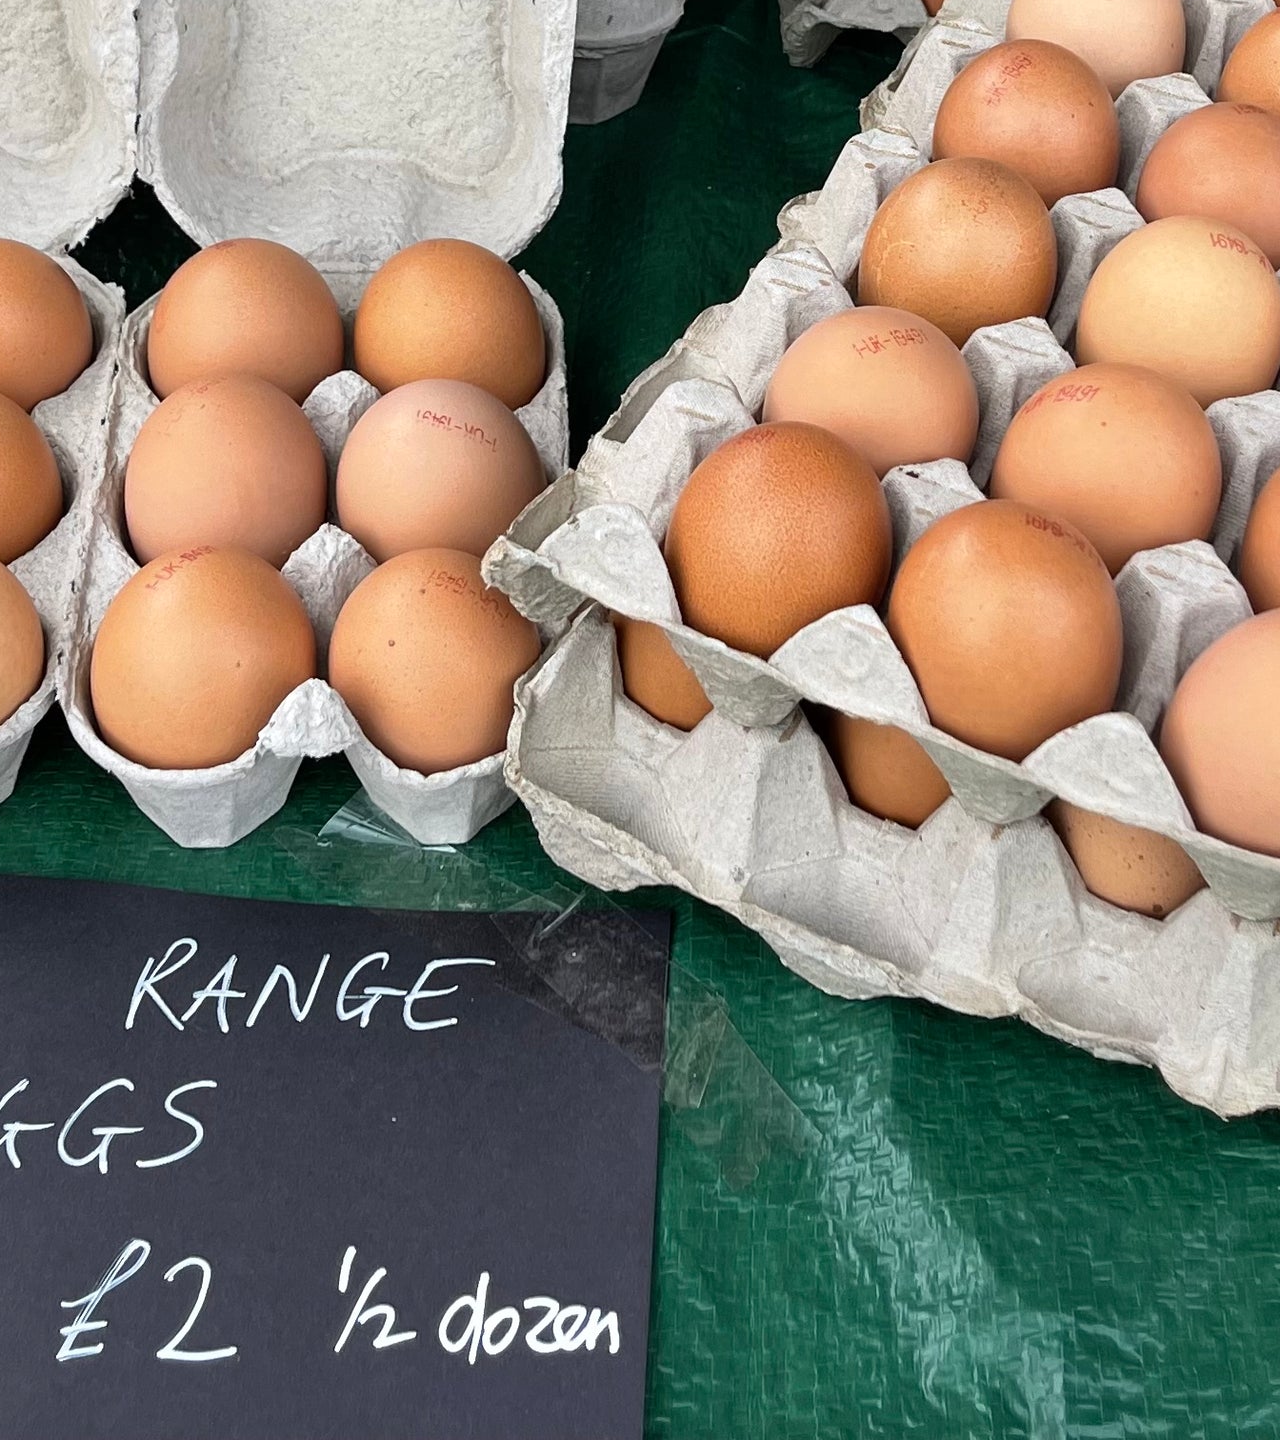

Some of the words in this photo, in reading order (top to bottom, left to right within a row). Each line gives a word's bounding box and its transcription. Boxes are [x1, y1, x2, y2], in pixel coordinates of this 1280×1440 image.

[124, 937, 496, 1034] RANGE
[55, 1237, 239, 1363] £2
[437, 1271, 622, 1366] dozen
